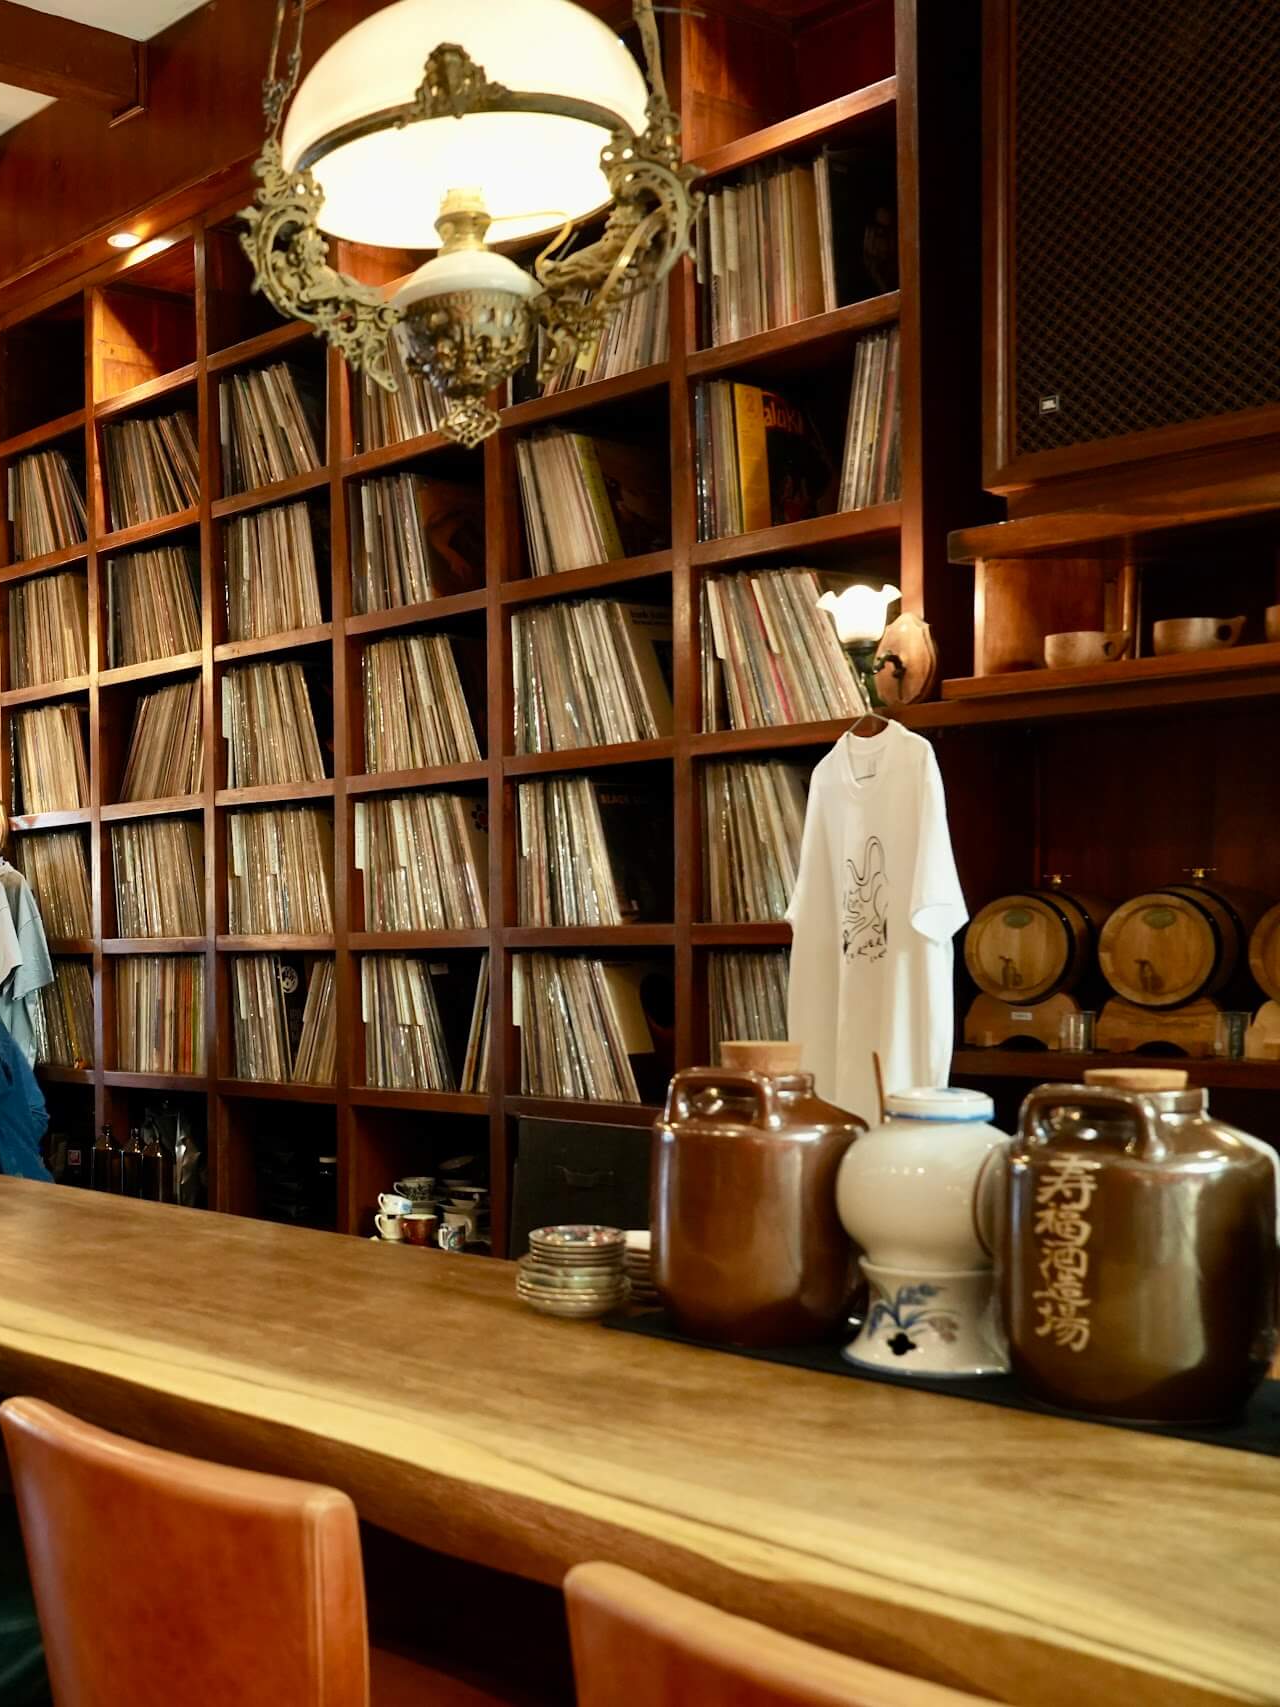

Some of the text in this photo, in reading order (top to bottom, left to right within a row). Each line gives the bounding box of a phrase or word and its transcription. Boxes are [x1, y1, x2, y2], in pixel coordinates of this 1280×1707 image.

[1032, 1151, 1102, 1352] 寿福酒造場
